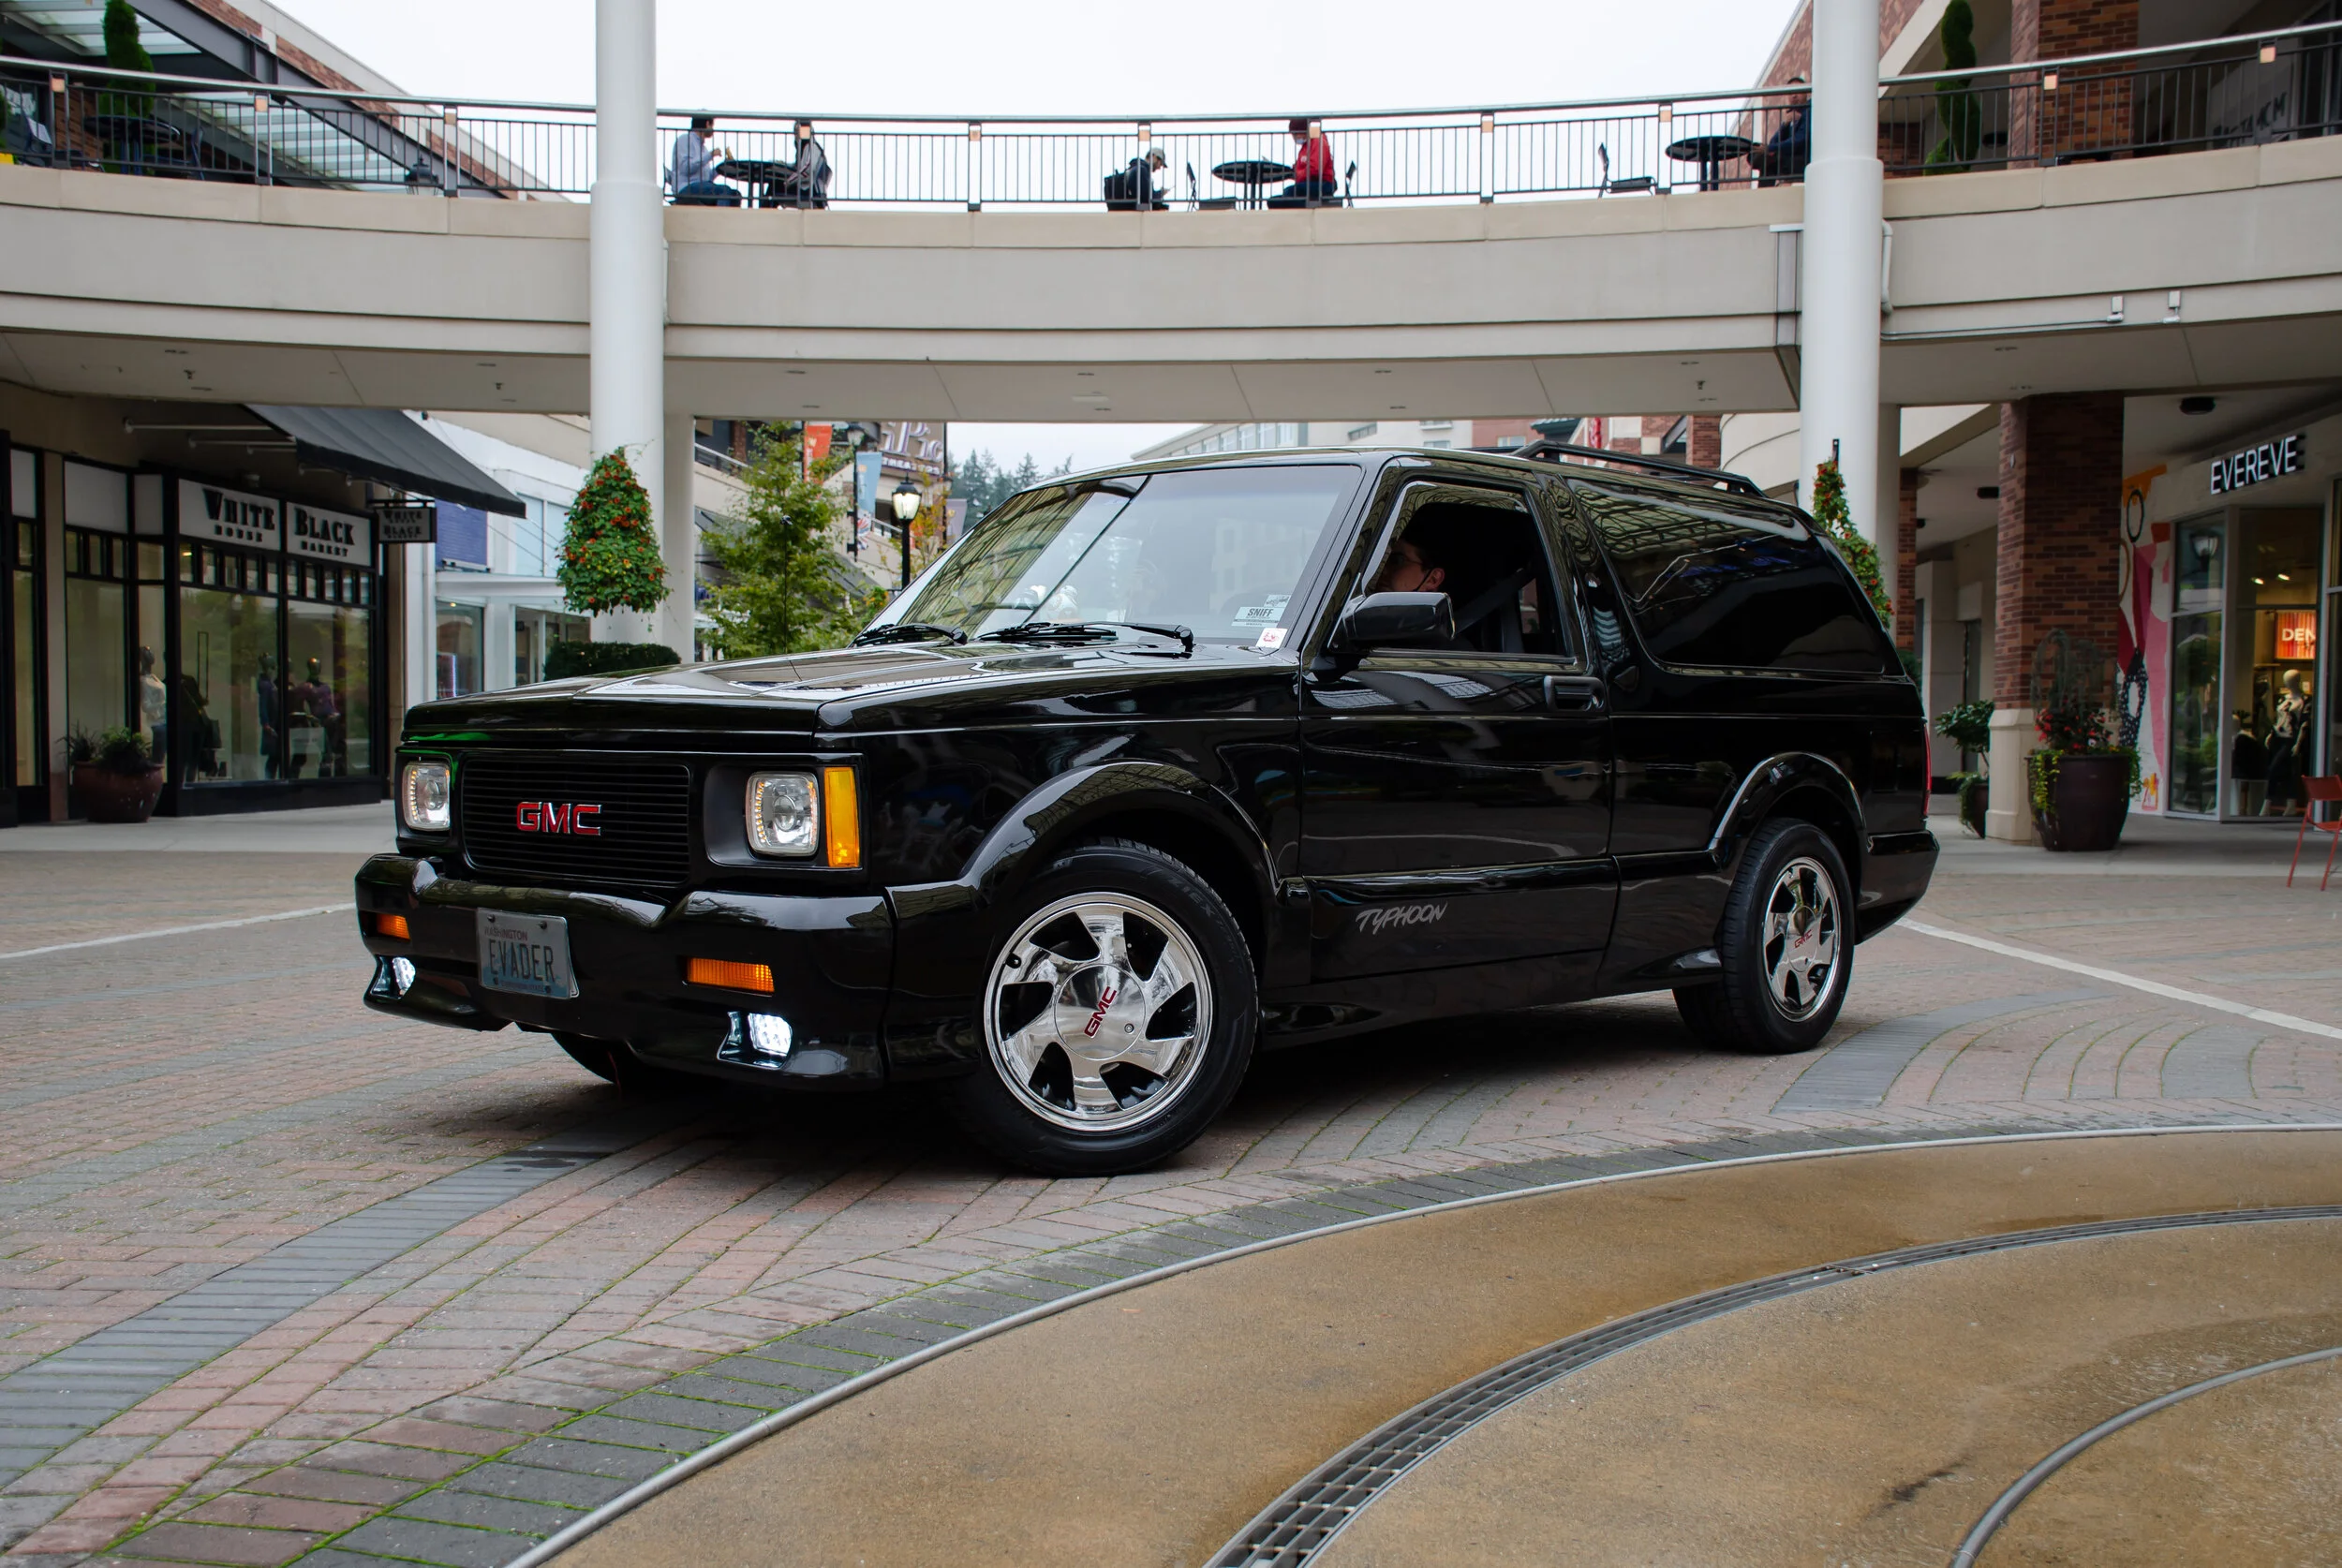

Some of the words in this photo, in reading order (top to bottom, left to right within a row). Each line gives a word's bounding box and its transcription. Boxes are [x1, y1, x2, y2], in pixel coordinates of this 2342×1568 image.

[880, 422, 942, 463] iPic
[2211, 436, 2297, 495] EVEREVE
[201, 488, 275, 531] WHITE
[294, 507, 355, 545] BLACK
[215, 525, 263, 542] HOUSE
[301, 540, 348, 557] MARKET
[1247, 608, 1274, 616] SNIFF
[516, 801, 602, 836] GMC
[1356, 901, 1448, 935] TYPHOON
[1795, 929, 1813, 948] GMC
[489, 939, 556, 983] EVADER
[1084, 986, 1118, 1039] GMC
